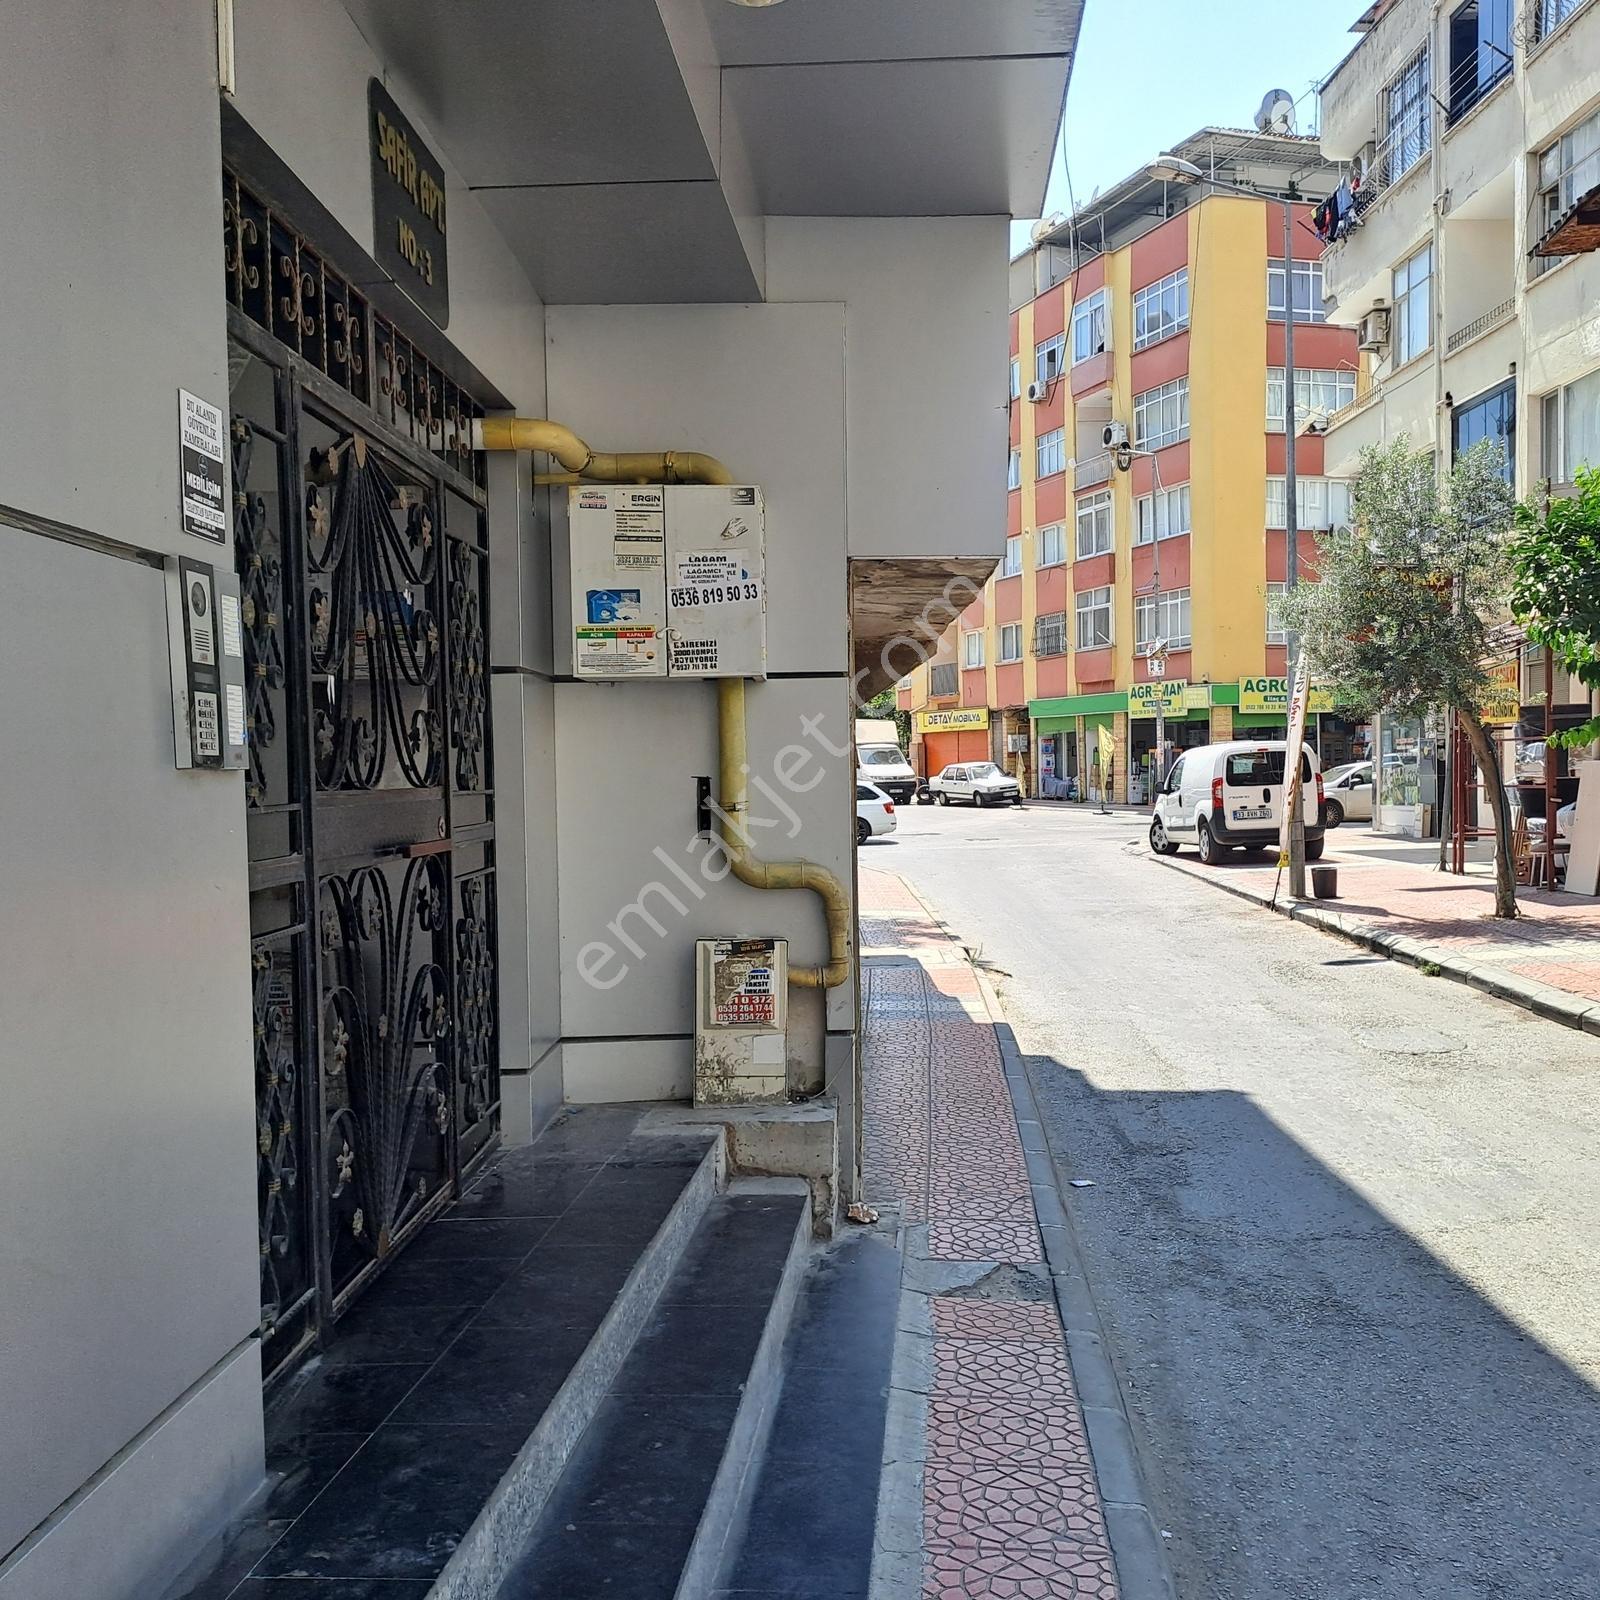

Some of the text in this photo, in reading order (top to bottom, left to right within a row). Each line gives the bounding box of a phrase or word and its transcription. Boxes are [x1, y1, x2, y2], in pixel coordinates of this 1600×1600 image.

[631, 494, 661, 502] ERGİN
[688, 555, 727, 563] LAĞAM
[671, 583, 758, 608] 0536 819 50 33
[691, 648, 718, 656] KOMPLE
[928, 712, 953, 725] DETAY
[718, 1004, 738, 1012] 0539
